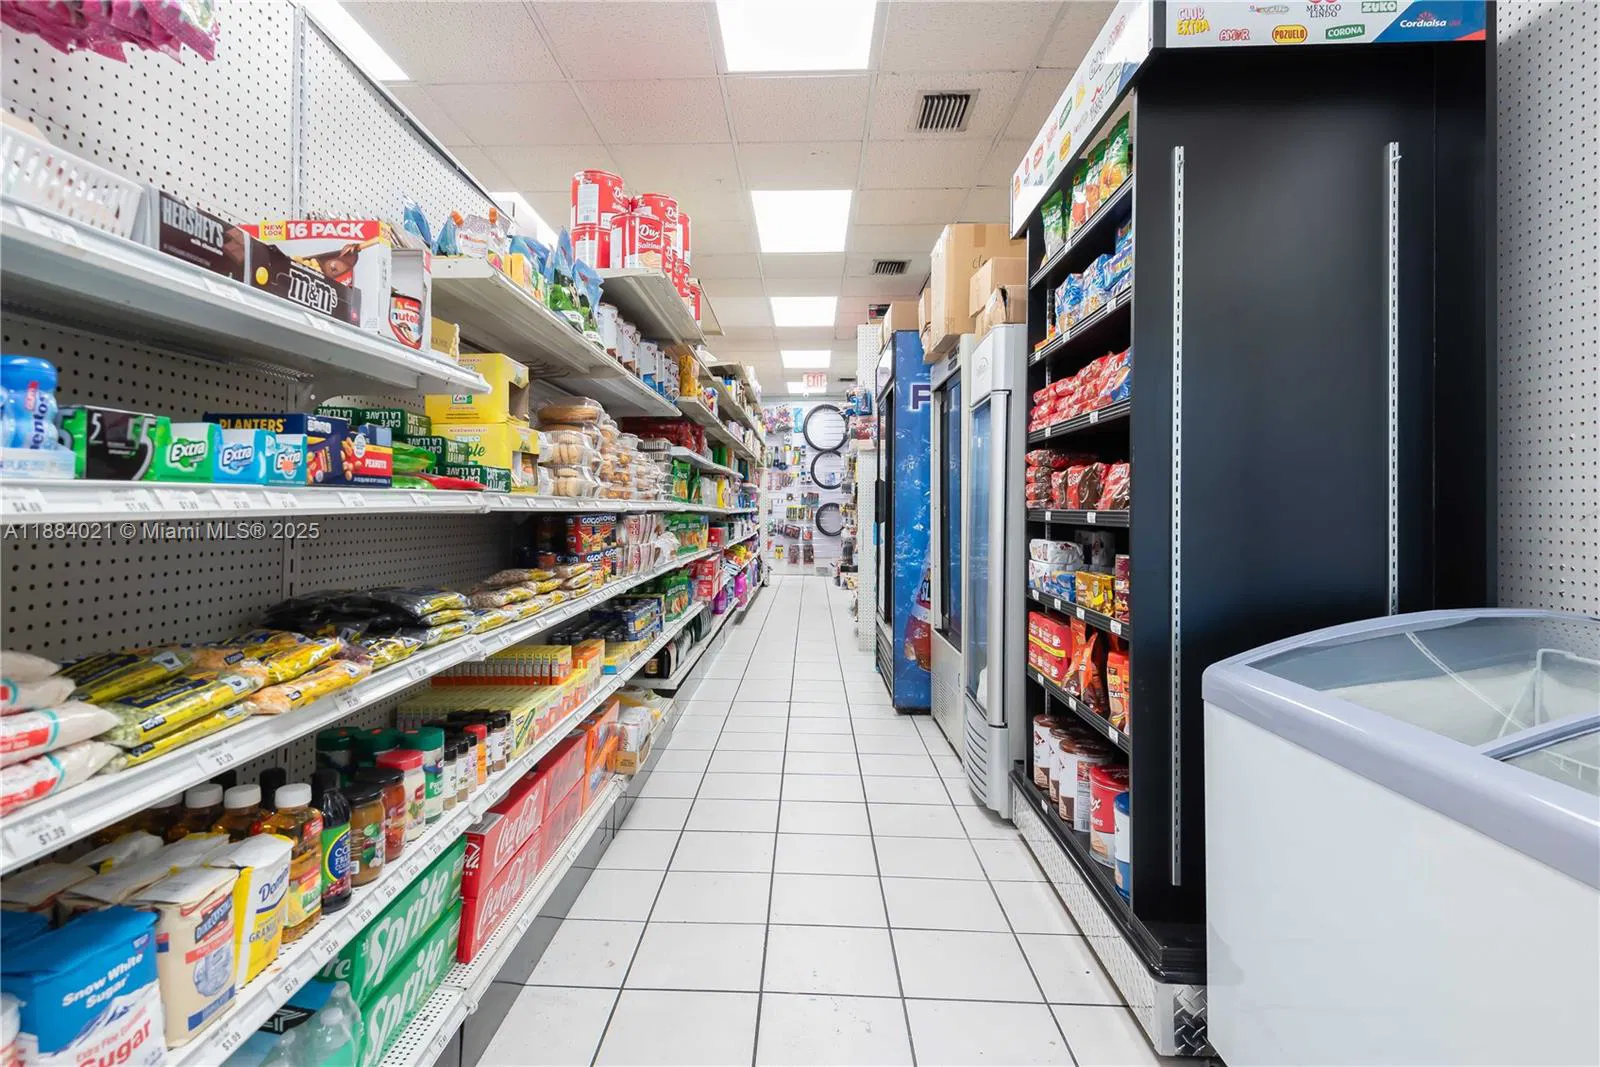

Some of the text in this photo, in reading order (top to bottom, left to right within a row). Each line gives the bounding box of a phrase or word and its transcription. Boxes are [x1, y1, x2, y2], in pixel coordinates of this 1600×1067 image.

[1362, 1, 1396, 12] ZUKO
[1178, 8, 1204, 20] CLUB
[1310, 10, 1337, 18] LINDO
[1177, 19, 1210, 35] EXTRA
[1400, 18, 1447, 28] Cordialsa
[1274, 29, 1305, 39] POZUELO
[1328, 26, 1363, 37] CORONA
[287, 223, 364, 238] 16 PACK
[639, 225, 660, 239] Dux
[219, 418, 284, 432] PLANTERS
[170, 440, 206, 462] Extra
[223, 446, 253, 465] Extra
[360, 871, 449, 996] Sprite
[62, 953, 143, 1007] Snow White
[86, 976, 127, 1009] Sugar
